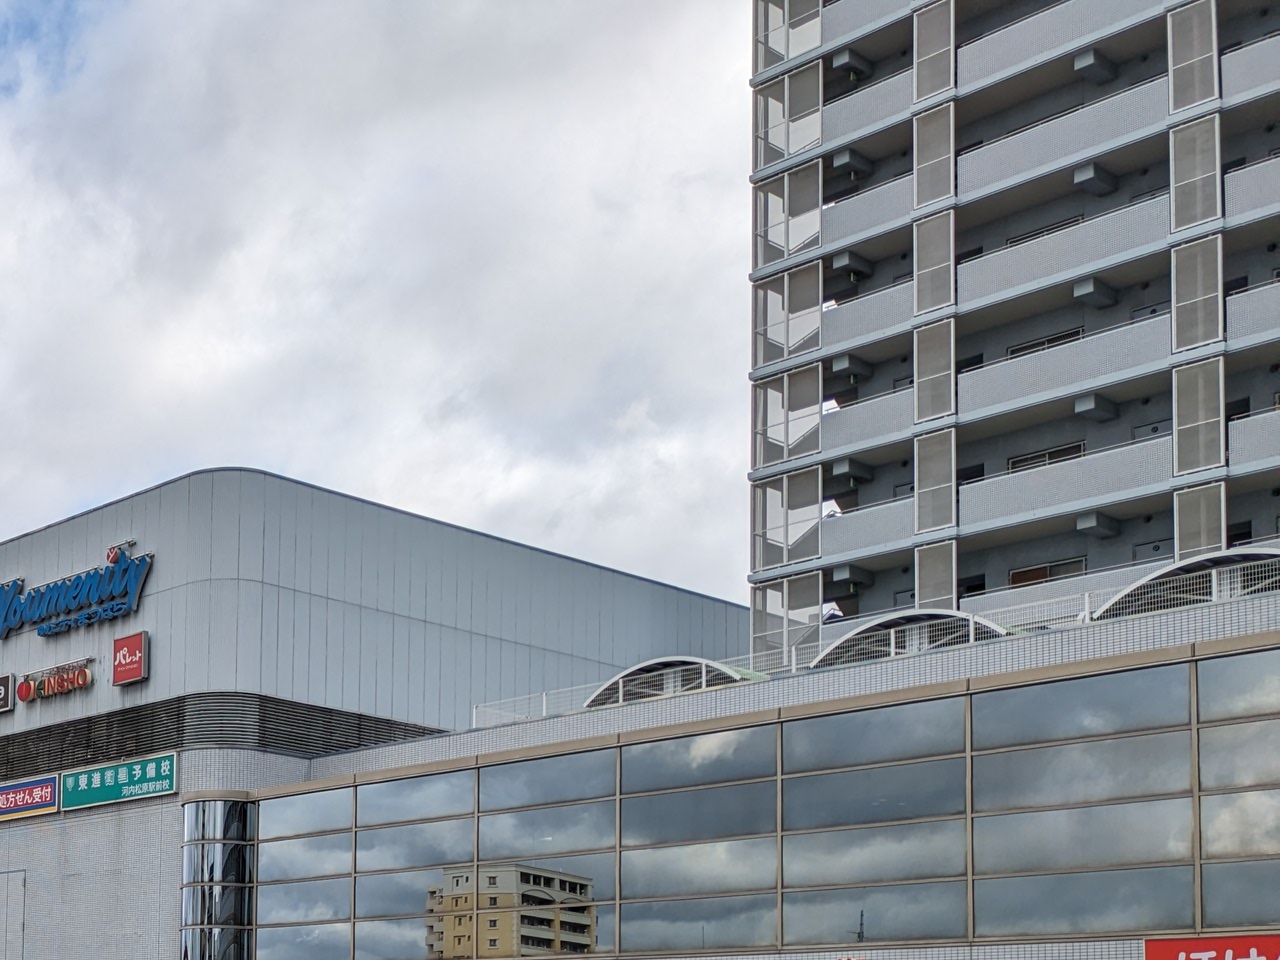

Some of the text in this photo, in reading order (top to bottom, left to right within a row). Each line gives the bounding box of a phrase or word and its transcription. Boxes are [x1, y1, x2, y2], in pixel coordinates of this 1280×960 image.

[115, 647, 141, 665] パレット
[78, 760, 171, 790] 東進衛星予備校
[121, 779, 170, 796] 河内松原駅前校
